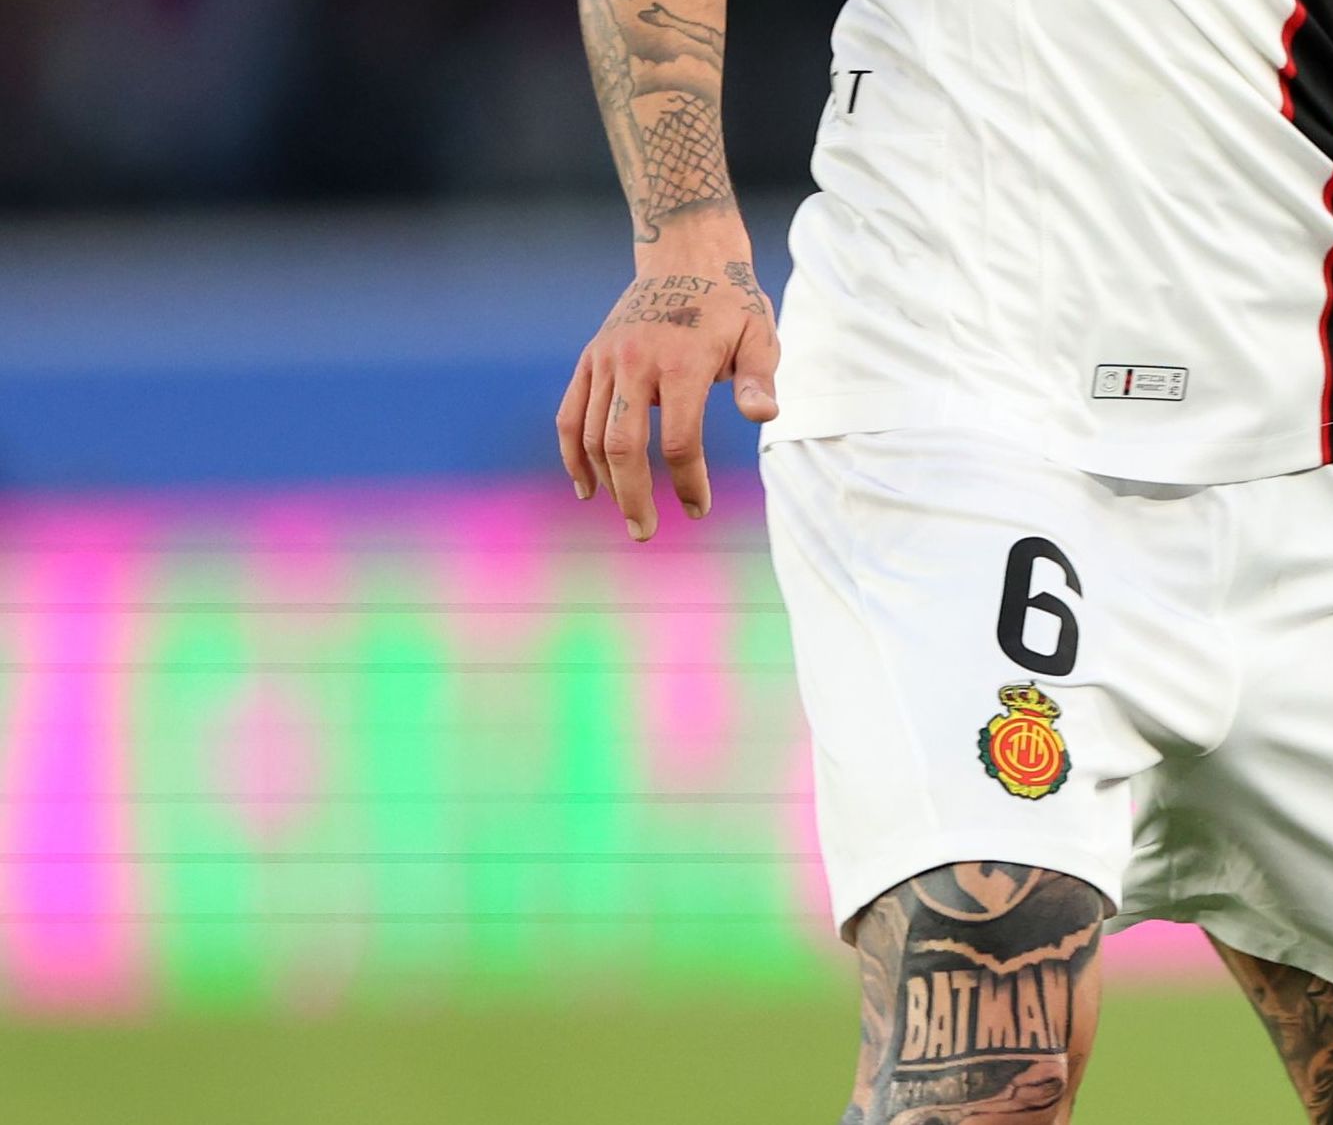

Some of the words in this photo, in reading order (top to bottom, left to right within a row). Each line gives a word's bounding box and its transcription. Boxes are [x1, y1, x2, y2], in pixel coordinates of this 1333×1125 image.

[650, 291, 697, 307] YET
[661, 275, 718, 295] BEST
[997, 536, 1083, 676] 6
[900, 963, 1070, 1062] BATMAN
